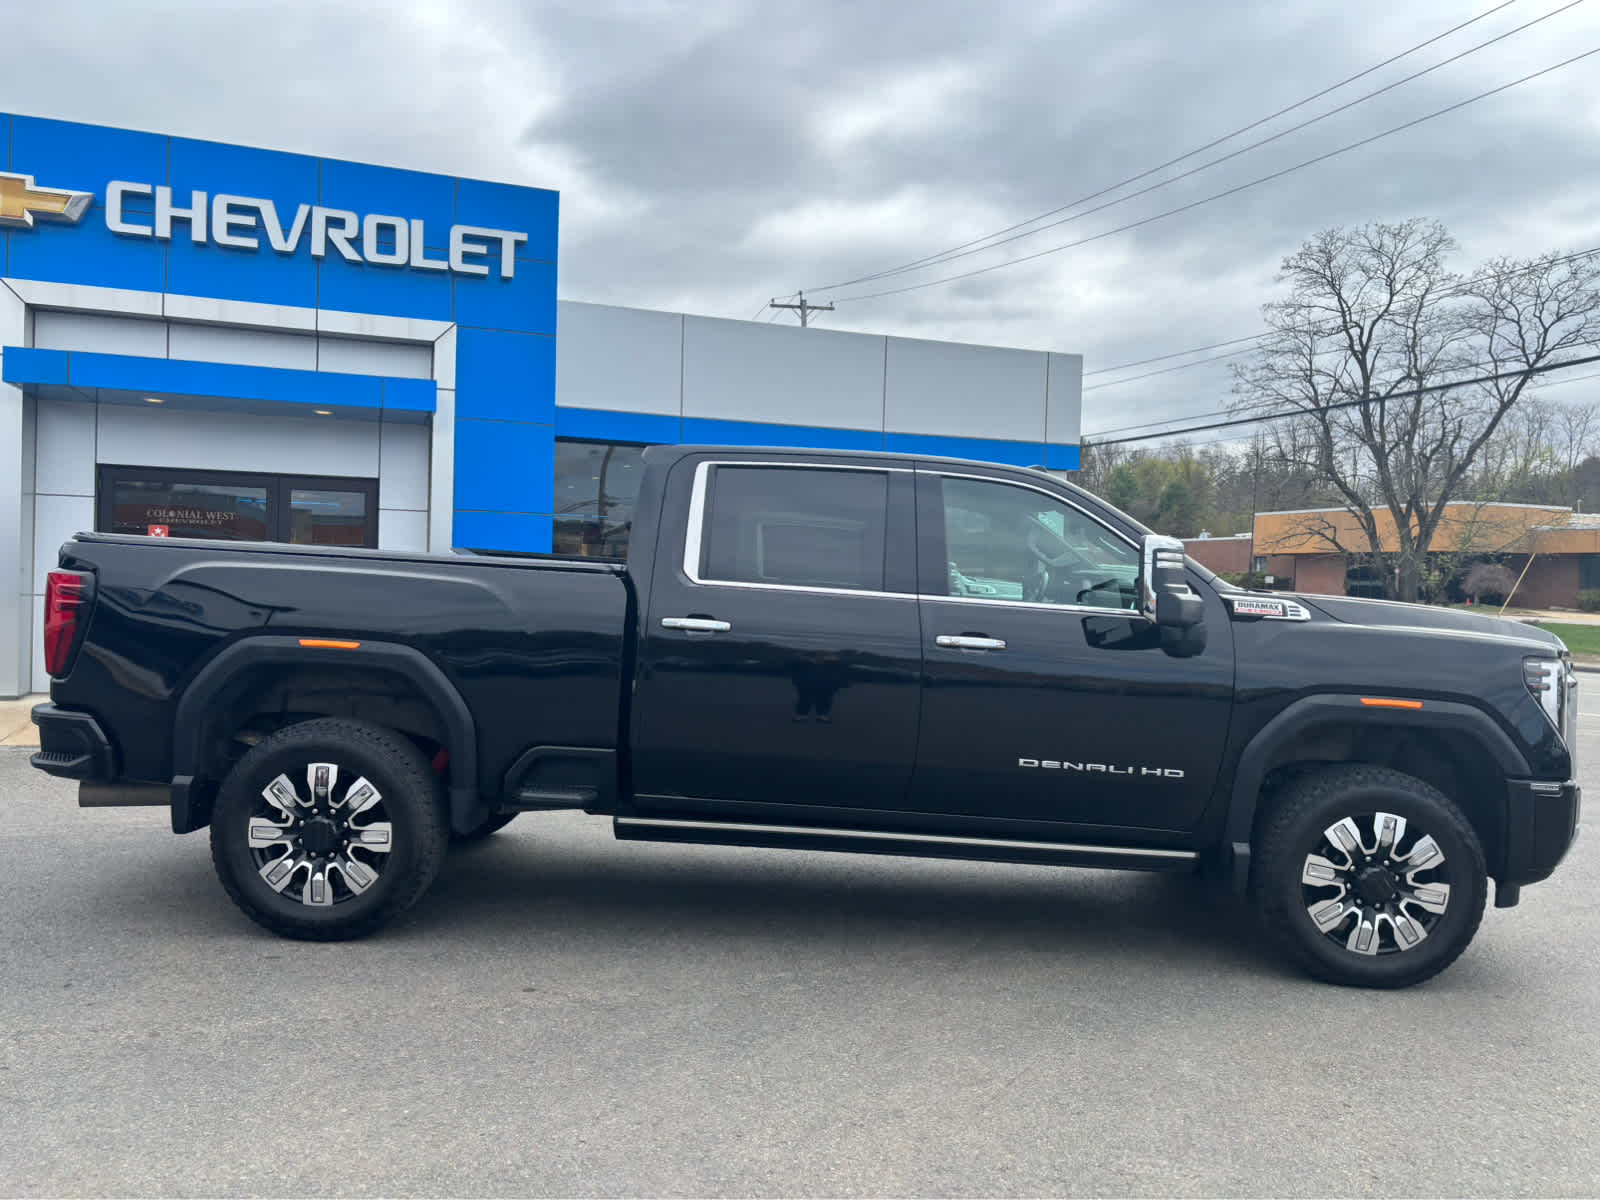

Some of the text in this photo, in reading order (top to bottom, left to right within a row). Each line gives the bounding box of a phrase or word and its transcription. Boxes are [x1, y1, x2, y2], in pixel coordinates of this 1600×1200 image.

[105, 179, 529, 279] CHEVROLET
[206, 511, 235, 521] WEST
[1018, 757, 1185, 778] DENALI HD
